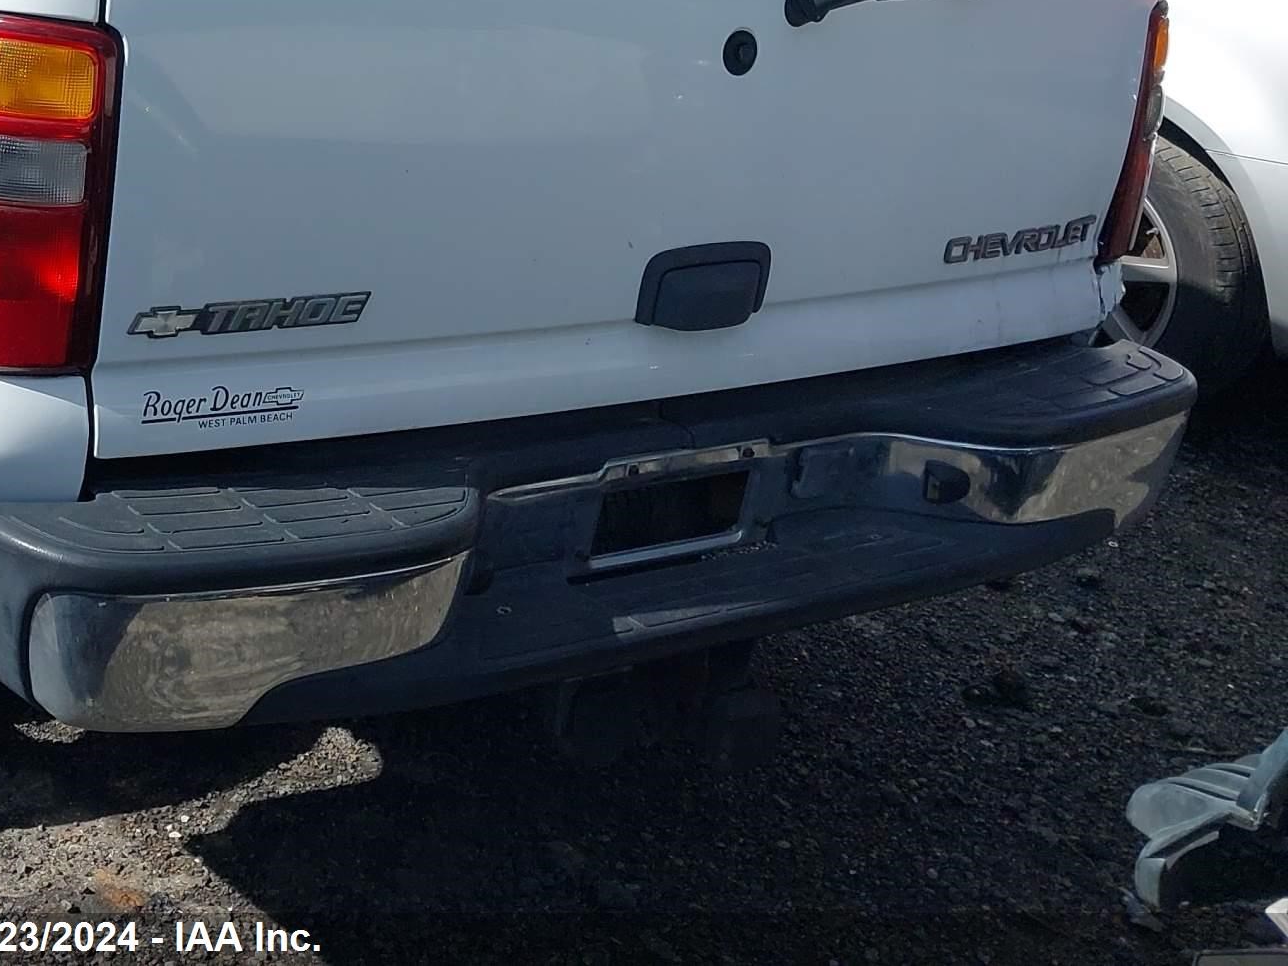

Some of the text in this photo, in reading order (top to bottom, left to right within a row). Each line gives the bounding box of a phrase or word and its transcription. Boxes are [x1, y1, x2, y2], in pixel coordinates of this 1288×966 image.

[943, 214, 1097, 264] CHEVROLET
[200, 291, 372, 335] TAHOE
[143, 385, 263, 423] Roger Dean
[266, 392, 302, 401] CHEVROLET
[198, 412, 294, 430] WEST PALM BEACH
